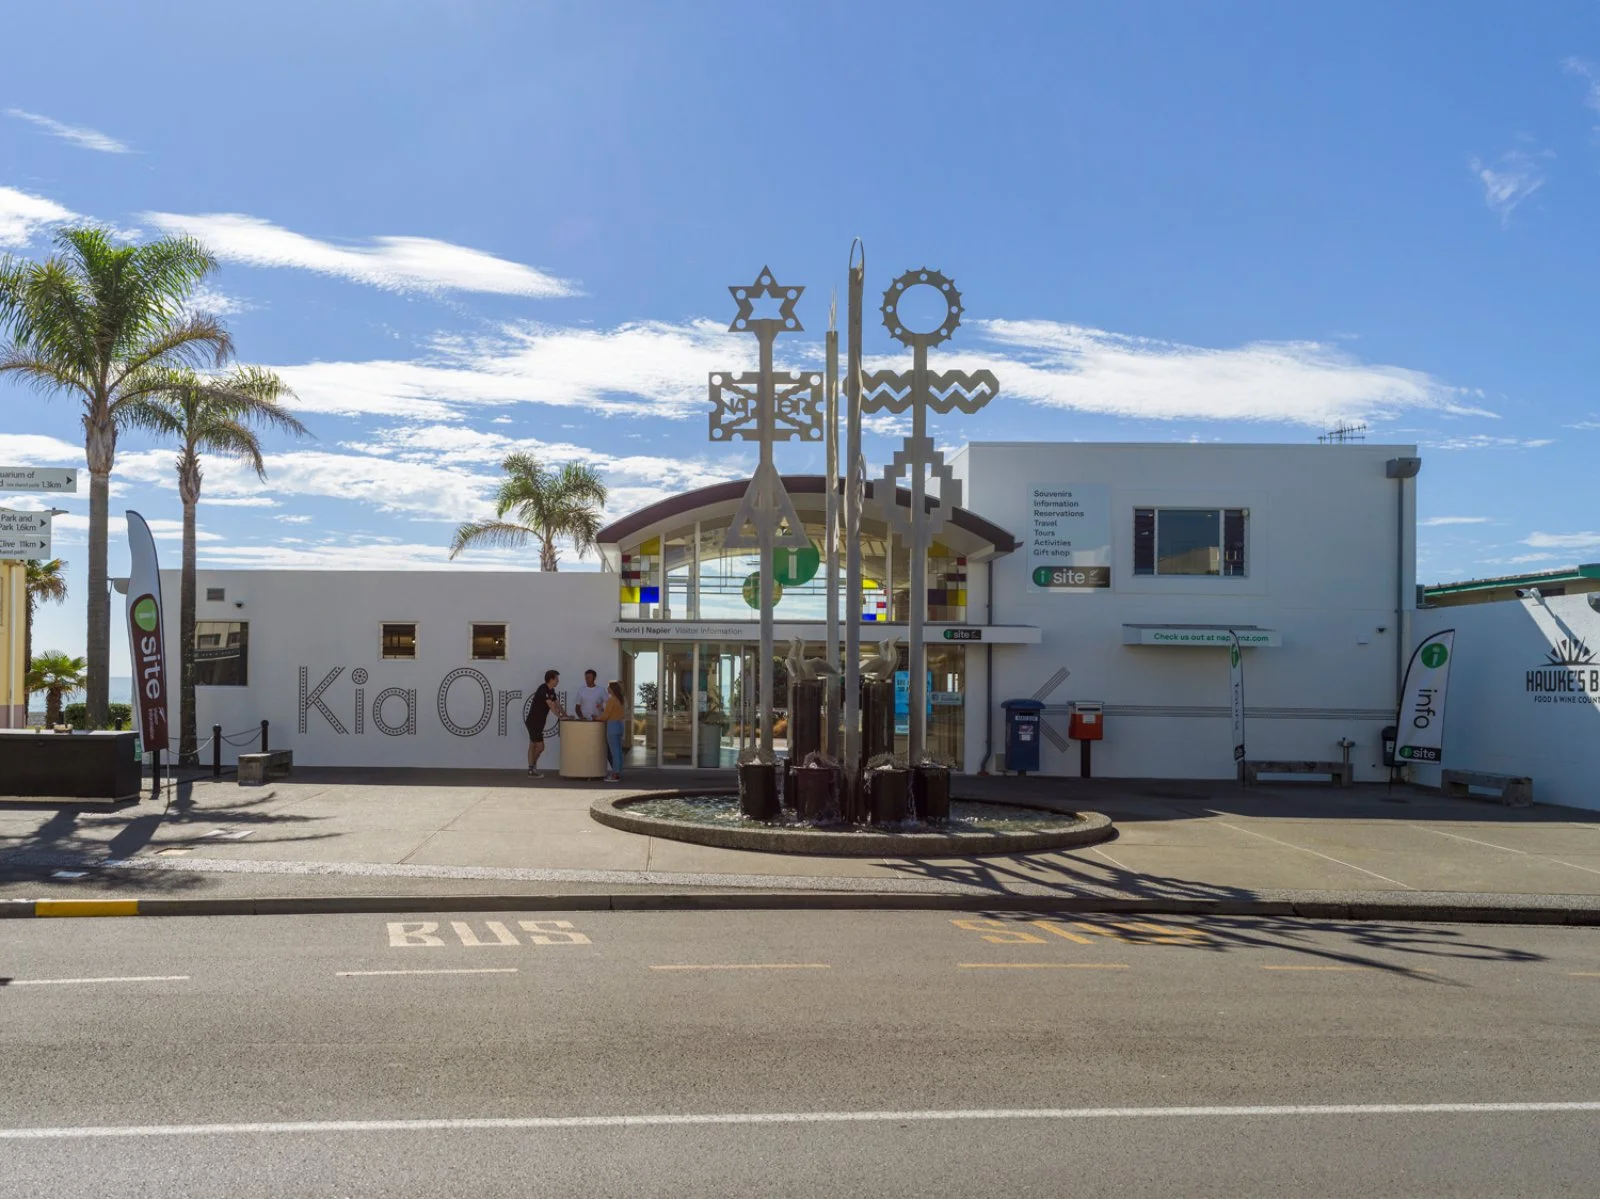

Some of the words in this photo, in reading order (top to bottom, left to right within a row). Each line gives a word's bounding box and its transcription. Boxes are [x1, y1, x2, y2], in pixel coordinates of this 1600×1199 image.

[27, 470, 35, 478] of
[1034, 490, 1072, 498] Souvenirs
[1, 514, 16, 522] Park
[19, 514, 32, 522] and
[1051, 549, 1070, 557] shop
[1053, 568, 1085, 584] site
[614, 626, 640, 634] Ahuriri
[646, 626, 671, 635] Napier
[675, 626, 698, 634] Visitor
[701, 627, 742, 635] Information
[953, 629, 970, 639] site
[1154, 632, 1178, 640] Check
[141, 636, 161, 700] site
[1526, 670, 1586, 692] HAWKE'S
[299, 666, 417, 736] Kia
[1534, 695, 1552, 703] FOOD
[1414, 688, 1438, 729] info
[1413, 747, 1436, 759] site
[386, 920, 592, 947] BUS
